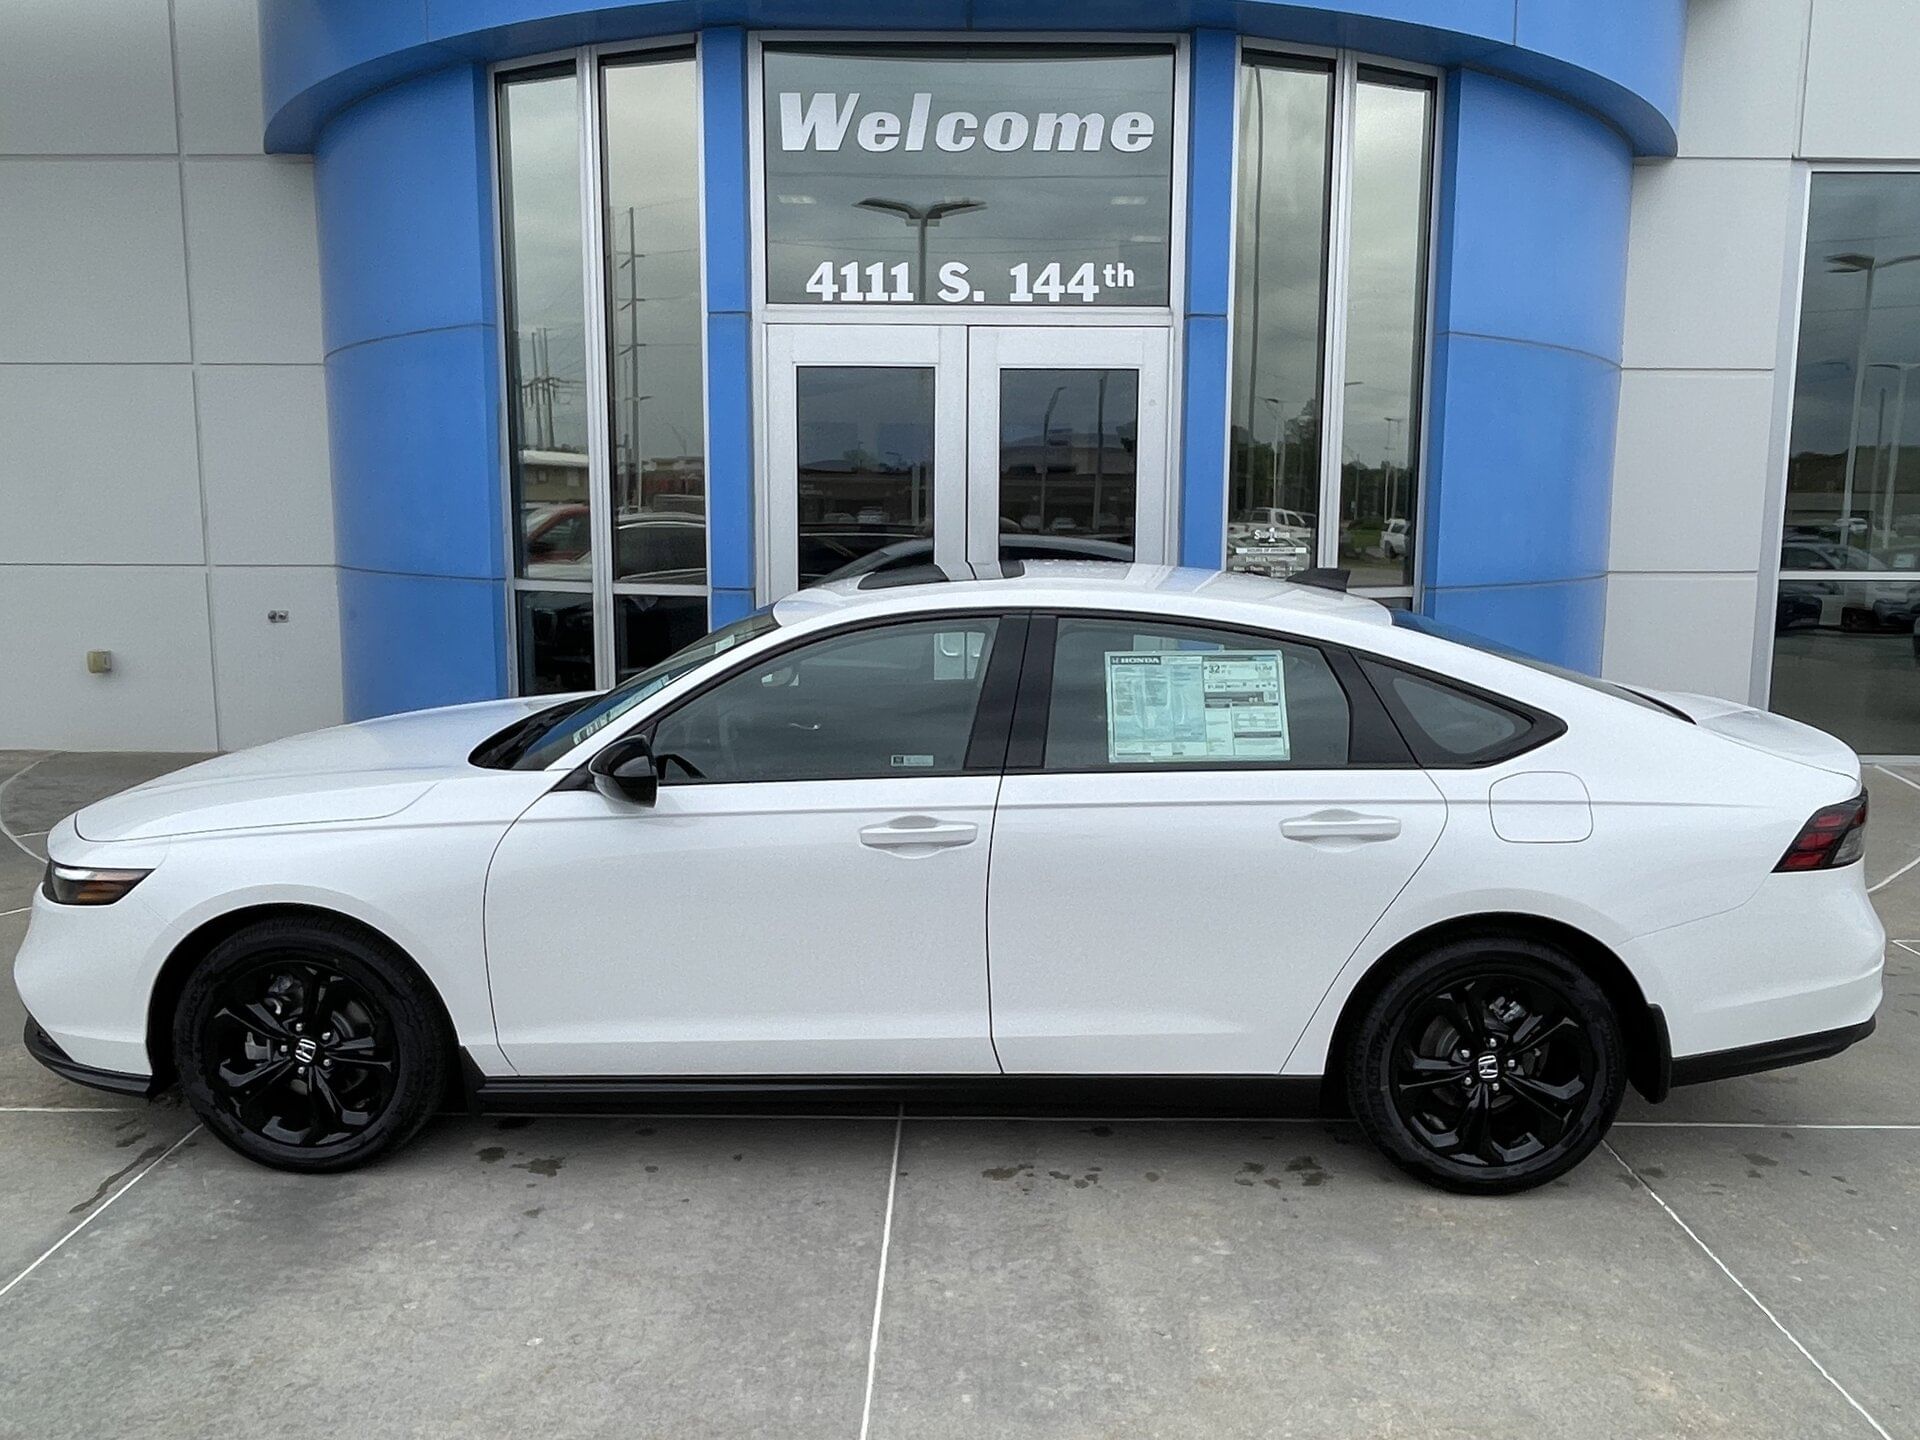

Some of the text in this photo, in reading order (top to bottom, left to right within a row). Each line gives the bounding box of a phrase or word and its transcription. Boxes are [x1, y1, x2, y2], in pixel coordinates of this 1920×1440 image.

[779, 93, 1155, 152] Welcome
[805, 261, 1135, 302] 4111 S. 144th
[1208, 664, 1220, 673] 32
